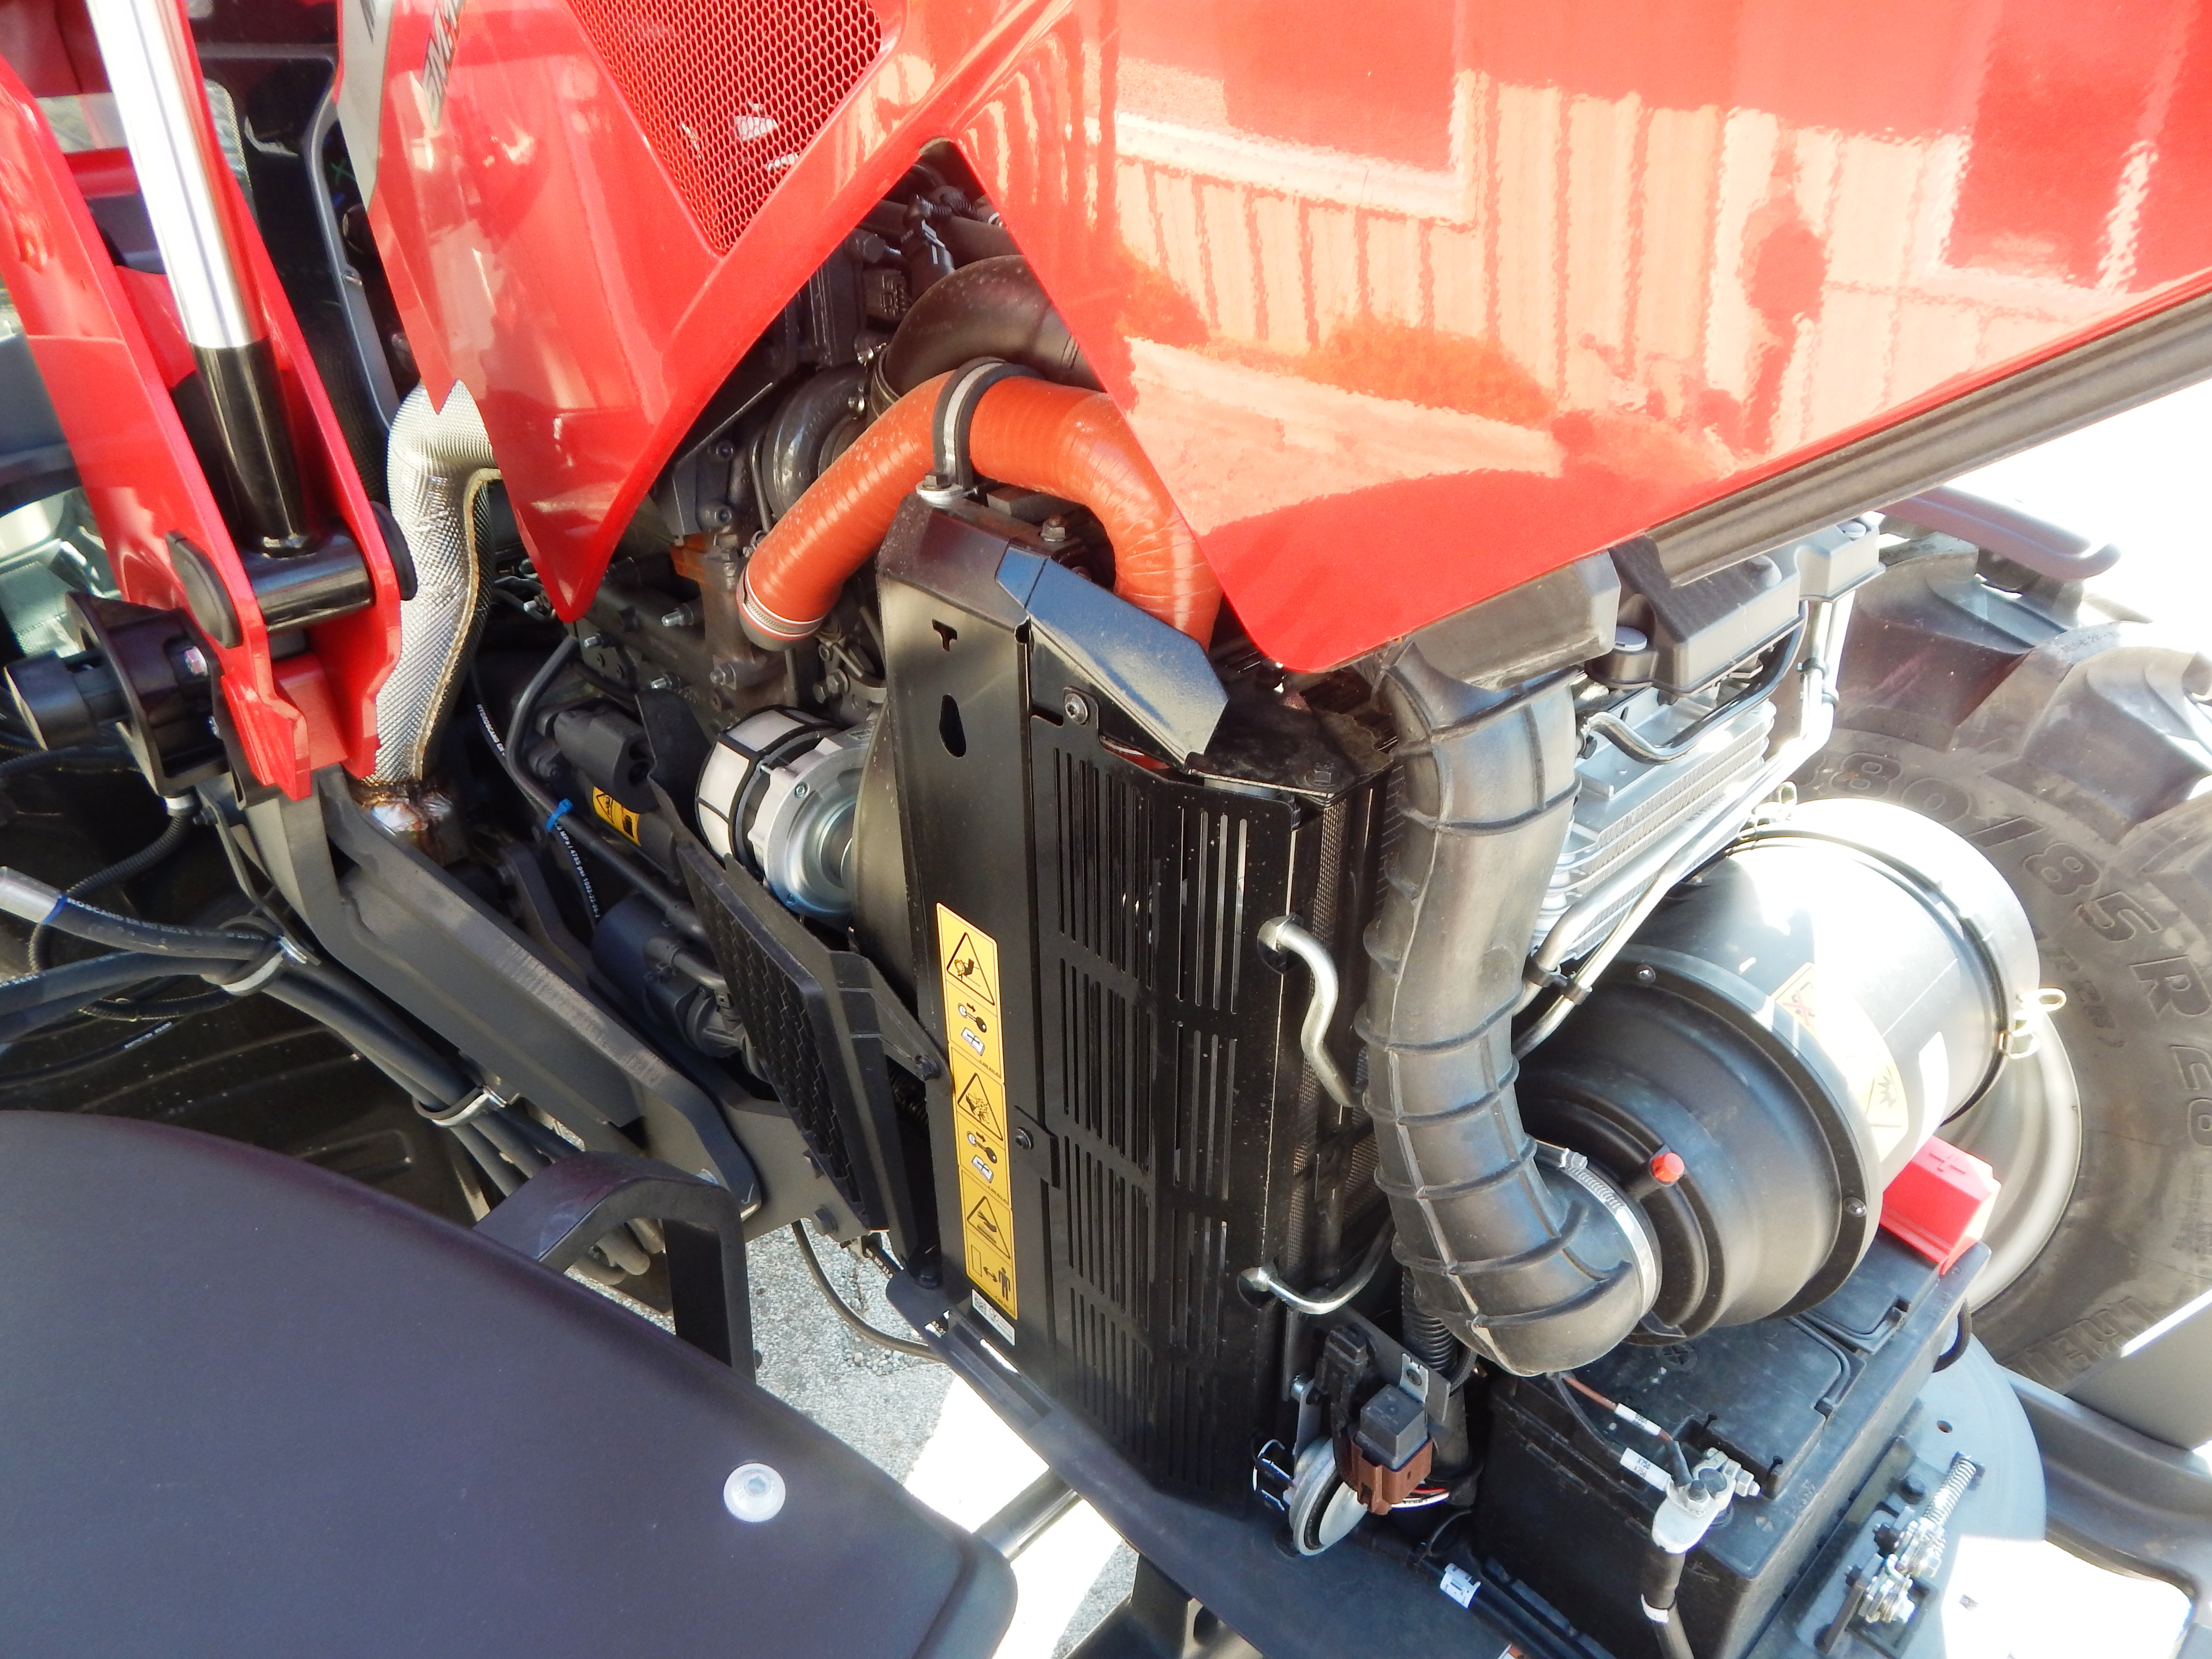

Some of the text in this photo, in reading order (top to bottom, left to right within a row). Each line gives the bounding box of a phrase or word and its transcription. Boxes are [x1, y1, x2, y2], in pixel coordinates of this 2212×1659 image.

[560, 831, 570, 845] MPa
[571, 850, 581, 865] 4785
[577, 866, 586, 877] psi
